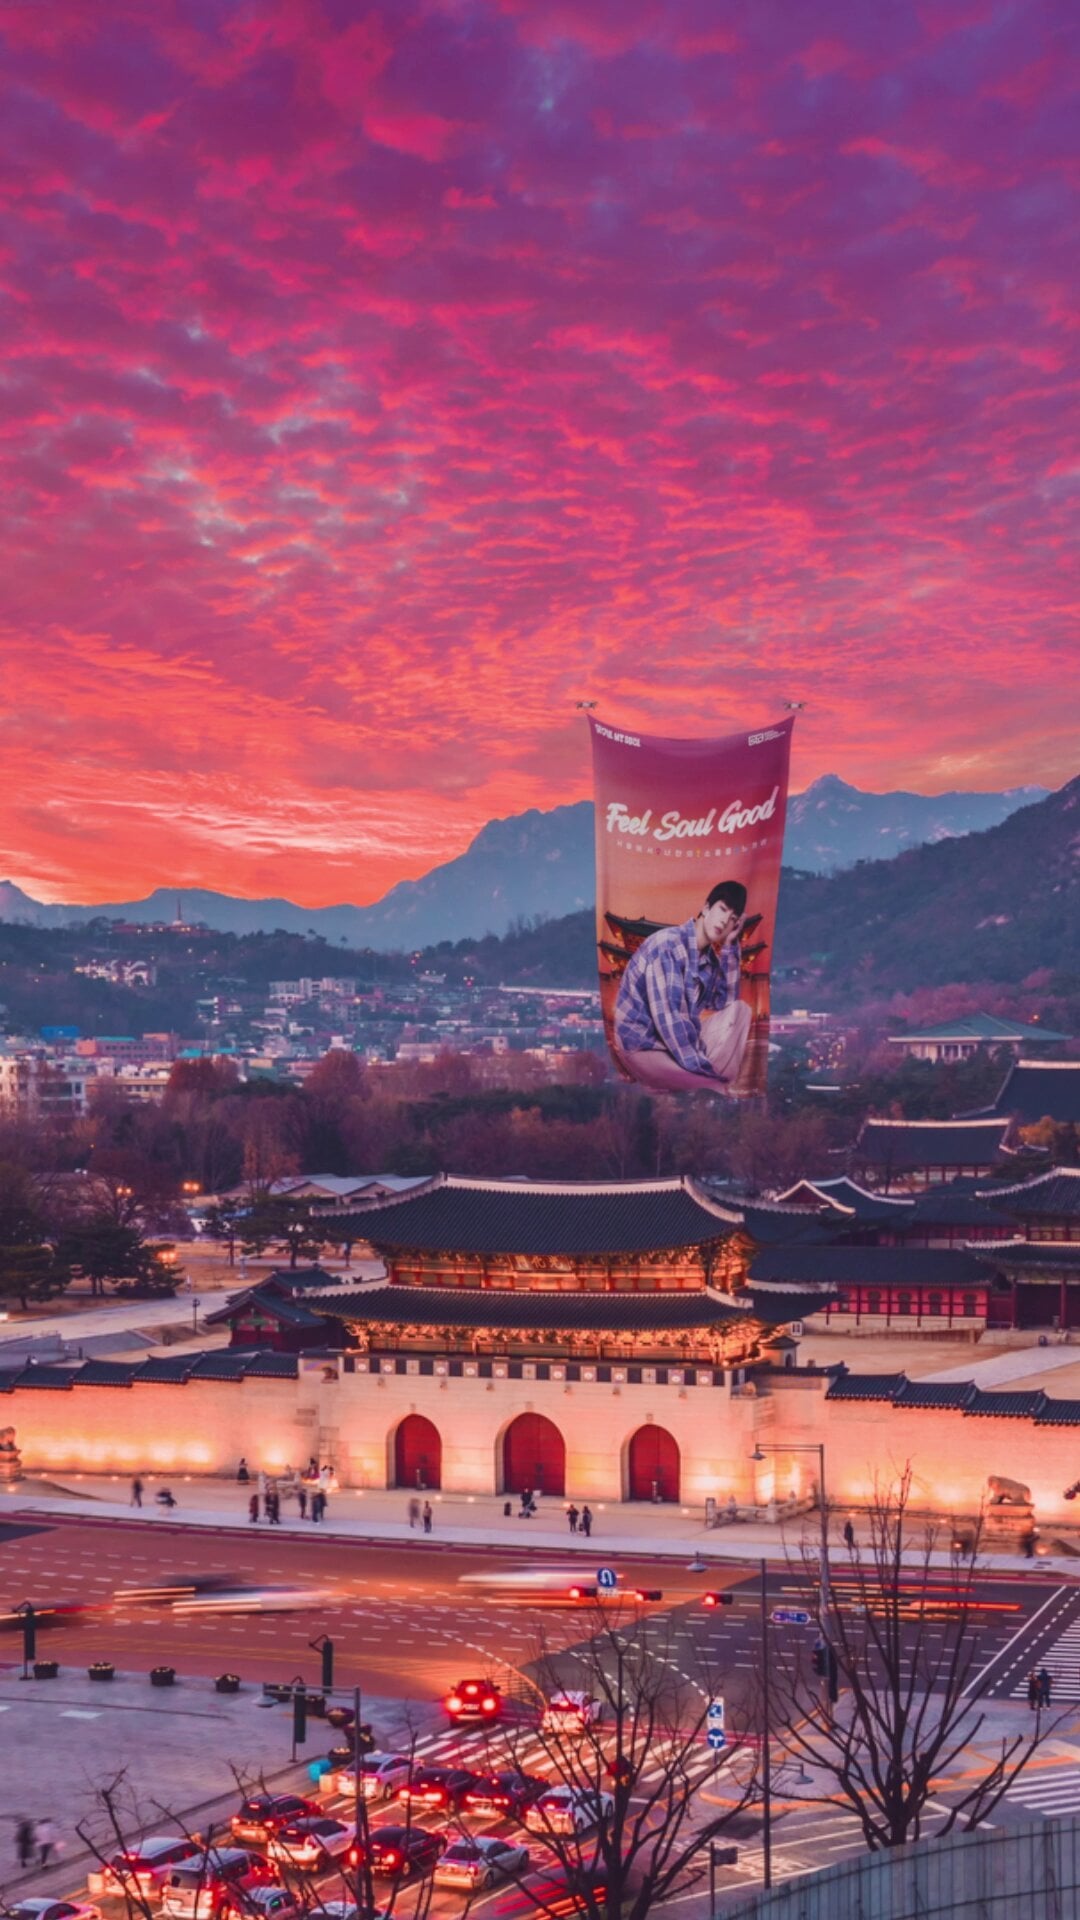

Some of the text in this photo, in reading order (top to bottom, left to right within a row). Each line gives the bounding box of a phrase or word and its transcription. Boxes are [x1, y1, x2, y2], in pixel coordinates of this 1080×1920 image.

[606, 785, 780, 841] Feel Soul Good
